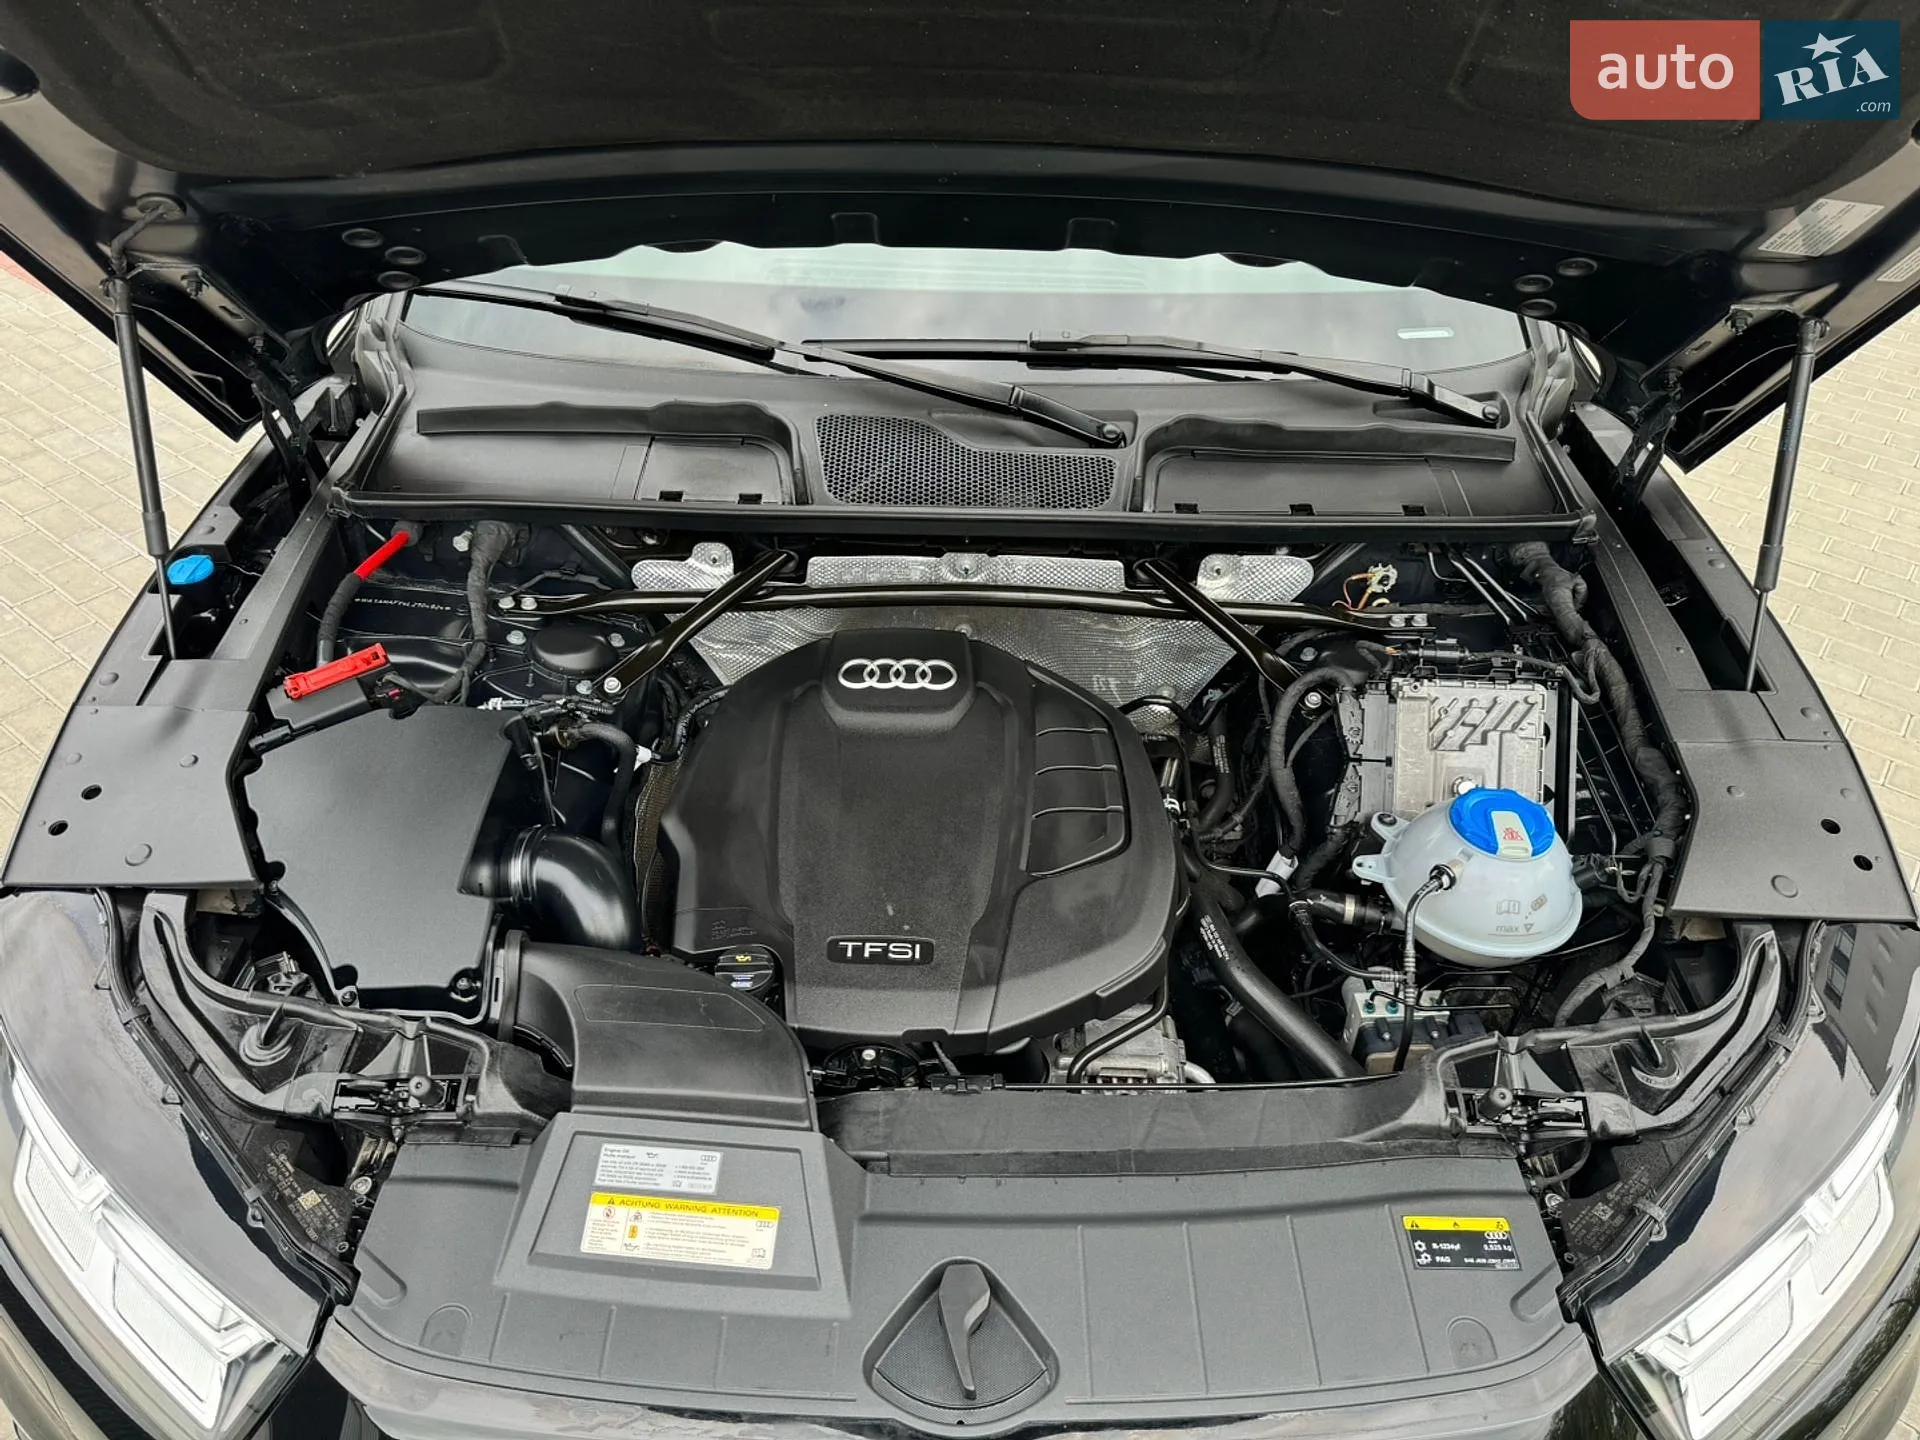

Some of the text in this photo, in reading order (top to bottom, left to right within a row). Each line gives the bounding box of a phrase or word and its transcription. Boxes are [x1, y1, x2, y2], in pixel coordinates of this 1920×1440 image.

[1496, 925, 1520, 933] max
[838, 941, 921, 960] TFSI
[619, 1199, 759, 1218] ACHTUNG WARNING ATTENTION
